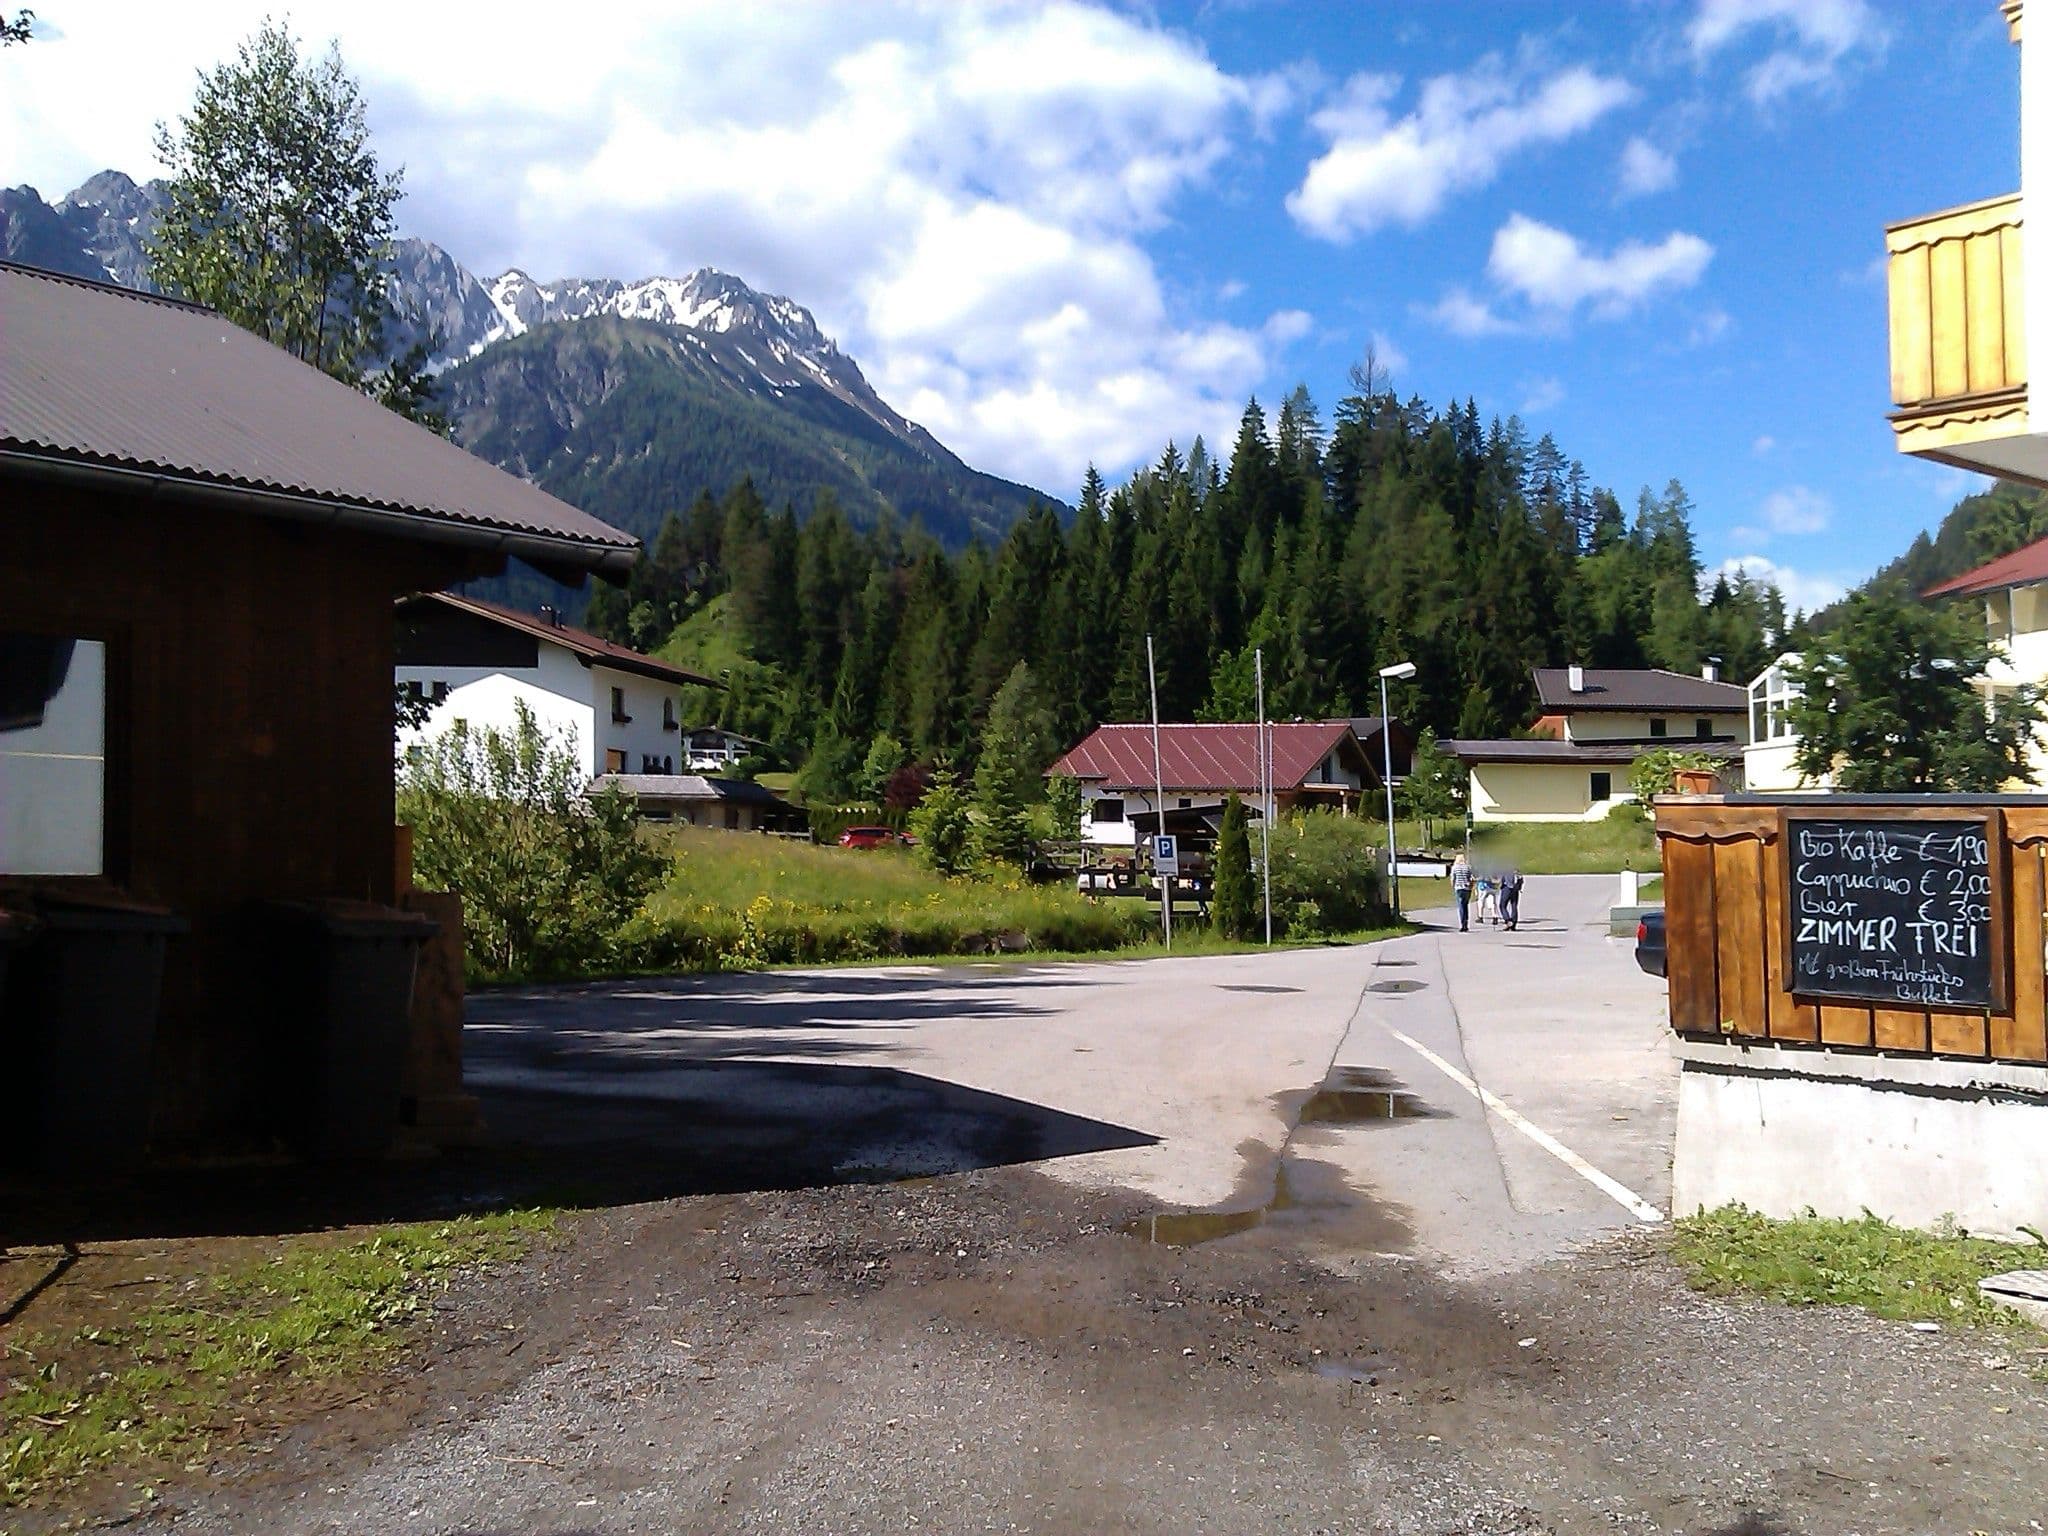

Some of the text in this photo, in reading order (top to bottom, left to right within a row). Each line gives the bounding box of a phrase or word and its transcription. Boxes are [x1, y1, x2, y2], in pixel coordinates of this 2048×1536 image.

[1161, 841, 1170, 855] P
[1919, 832, 1939, 861] €
[1919, 869, 1938, 896] €
[1800, 888, 1859, 917] Bier
[1918, 899, 1937, 923] €
[1796, 916, 1898, 952] ZIMMER
